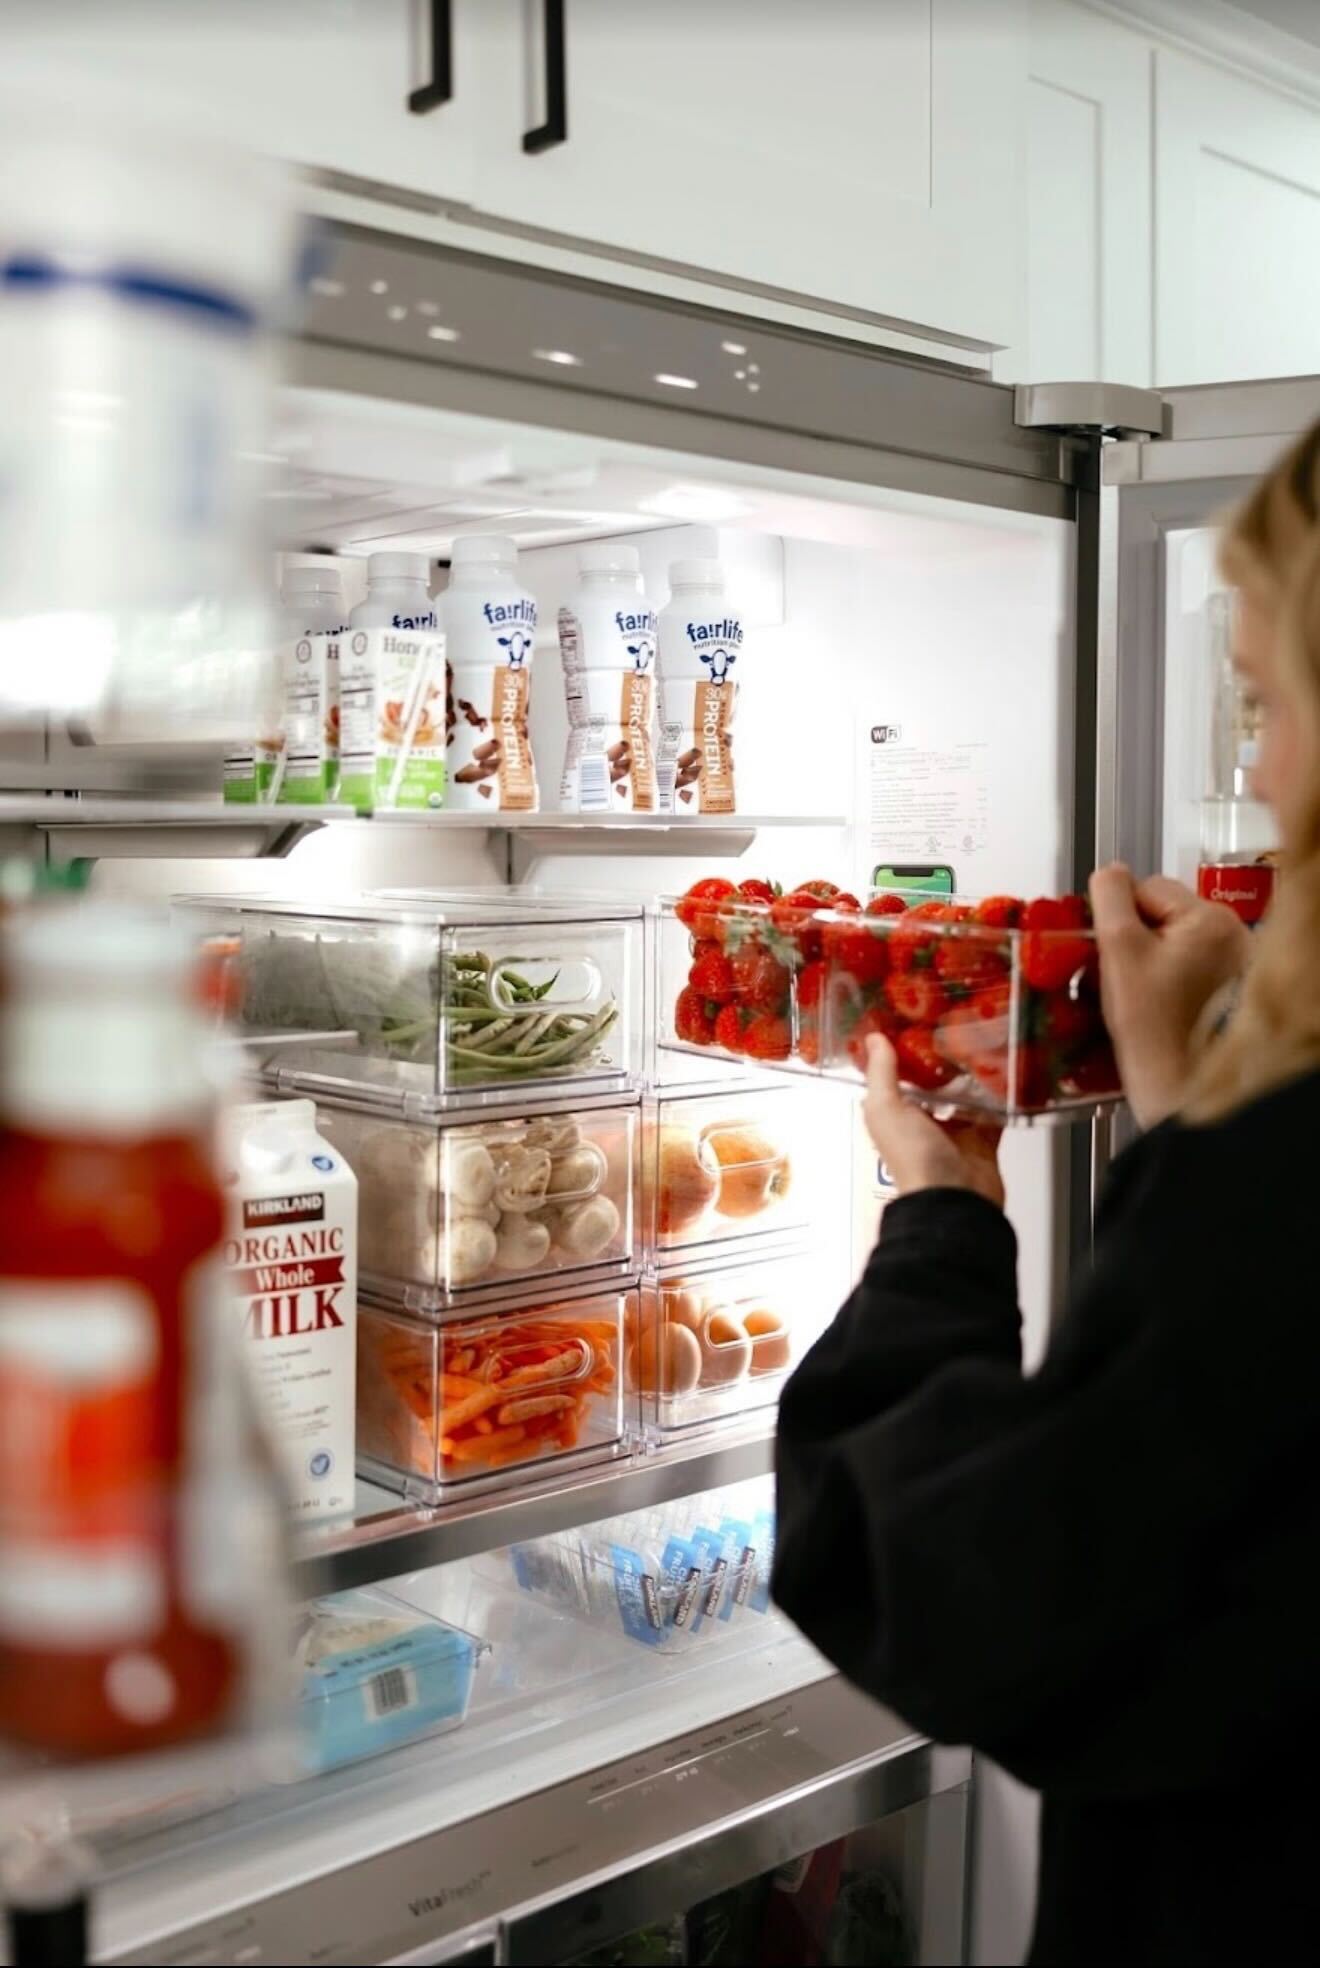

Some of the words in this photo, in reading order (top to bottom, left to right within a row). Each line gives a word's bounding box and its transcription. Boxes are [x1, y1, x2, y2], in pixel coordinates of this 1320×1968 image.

[502, 688, 522, 769] PROTEIN
[629, 693, 647, 770] PROTEIN
[703, 700, 722, 775] PROTEIN
[247, 1195, 322, 1216] KIRKLAND
[255, 1264, 315, 1291] Whole
